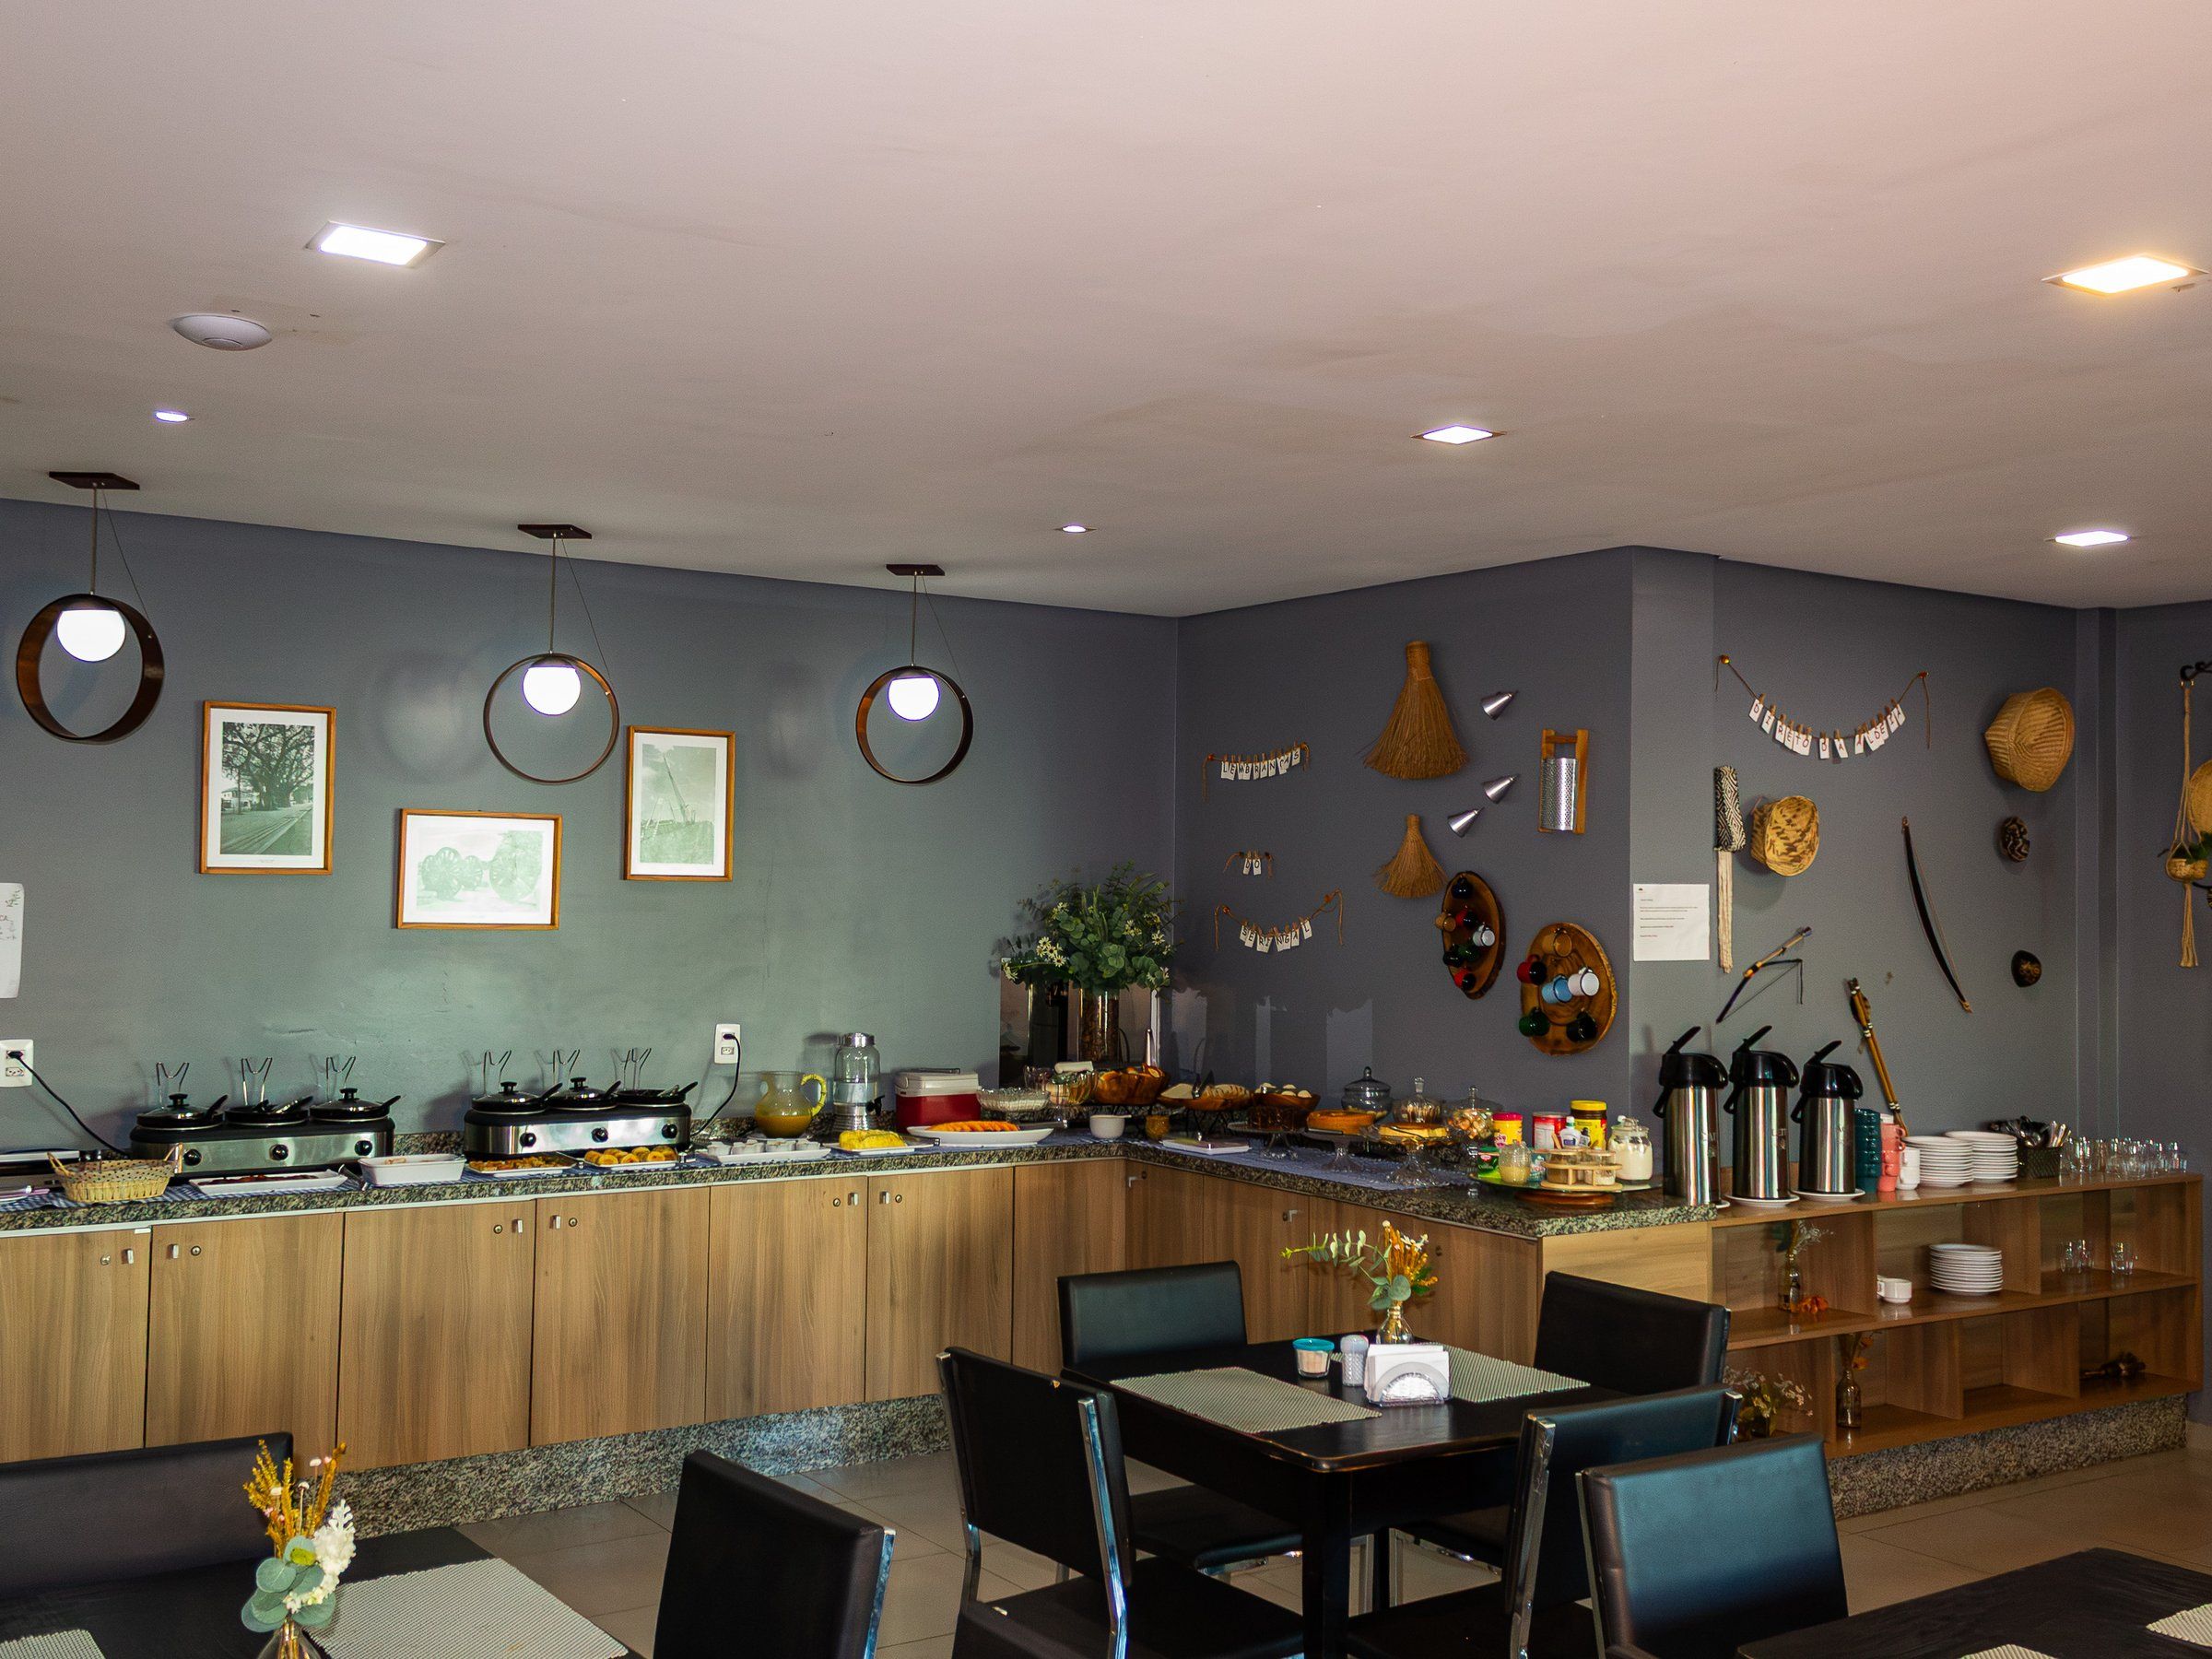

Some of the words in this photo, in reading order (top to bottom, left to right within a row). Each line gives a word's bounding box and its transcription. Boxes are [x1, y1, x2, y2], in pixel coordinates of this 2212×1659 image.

[1752, 702, 1810, 748] DIRETO
[1855, 707, 1902, 747] ALDEIA
[1244, 859, 1260, 869] DO
[1241, 924, 1311, 947] SERINGAL
